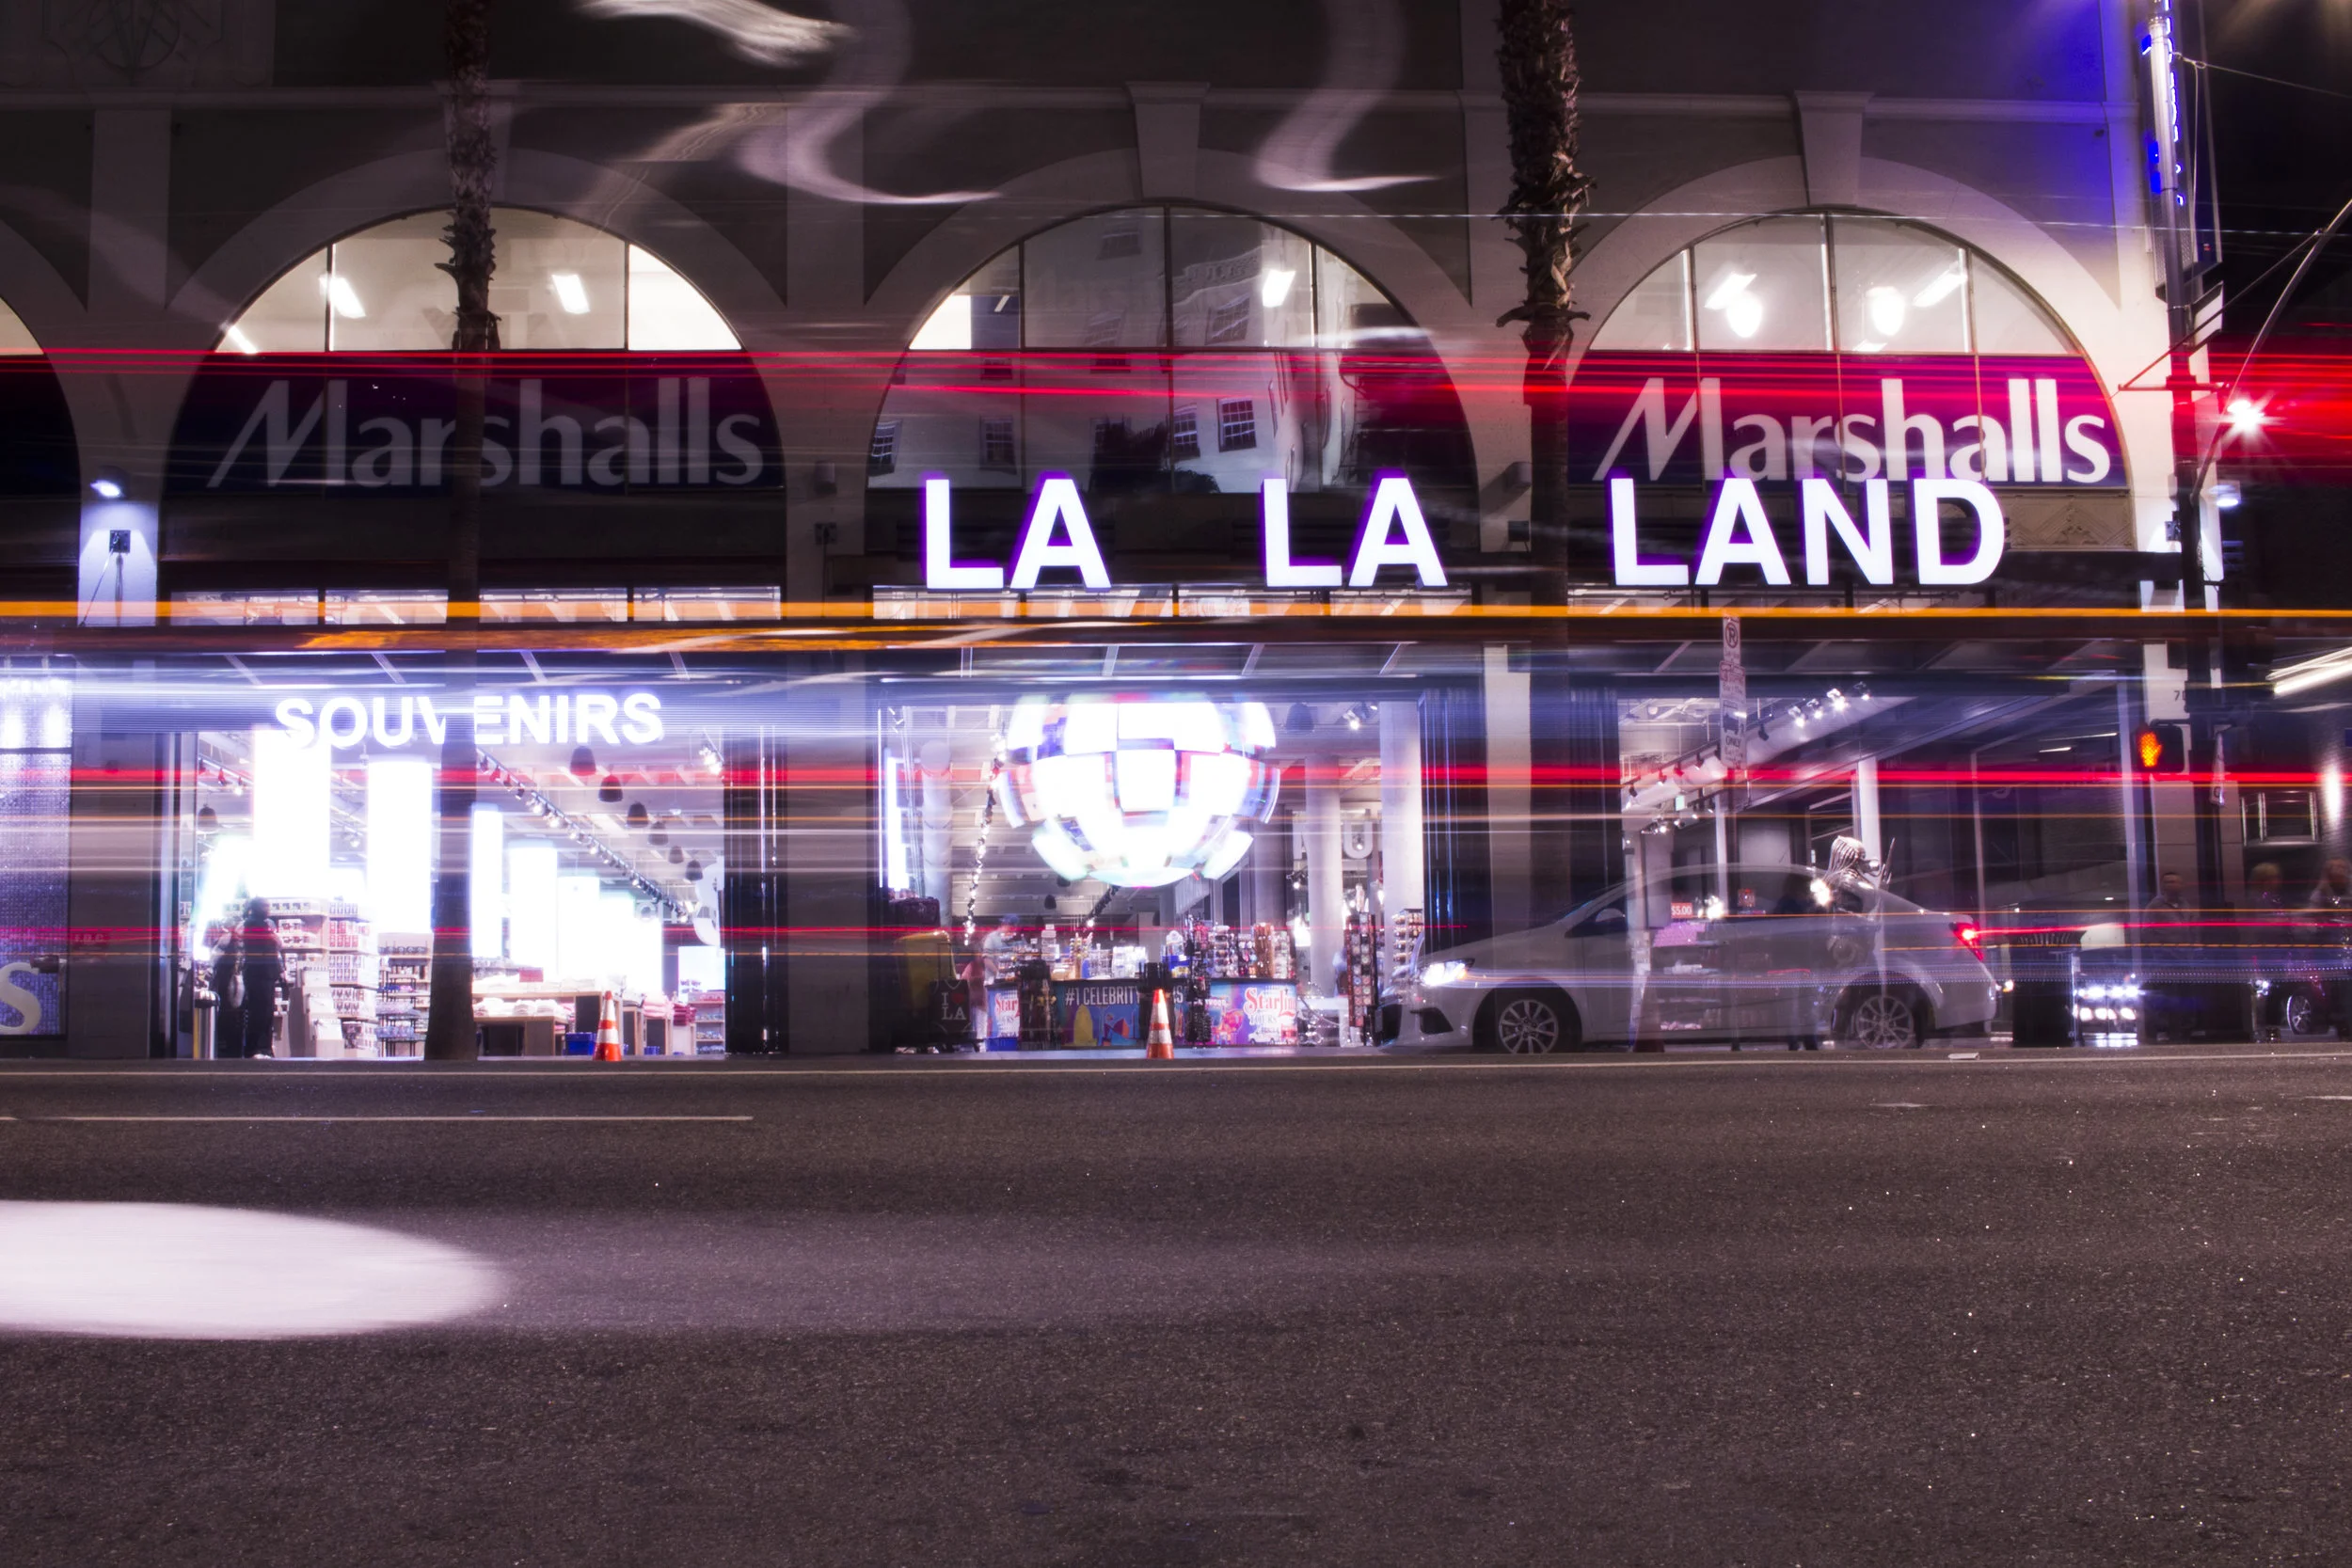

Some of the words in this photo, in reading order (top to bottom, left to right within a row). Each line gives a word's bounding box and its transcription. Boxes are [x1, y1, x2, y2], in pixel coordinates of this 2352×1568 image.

[207, 377, 763, 487] Marshalls
[1593, 377, 2111, 483] Marshalls
[923, 478, 1111, 590] LA
[1262, 477, 1448, 587] LA
[1611, 477, 2005, 585] LAND
[275, 692, 663, 752] SOUVENIRS
[1671, 905, 1692, 915] $5.00
[942, 1006, 966, 1021] LA
[1065, 988, 1080, 1006] #1
